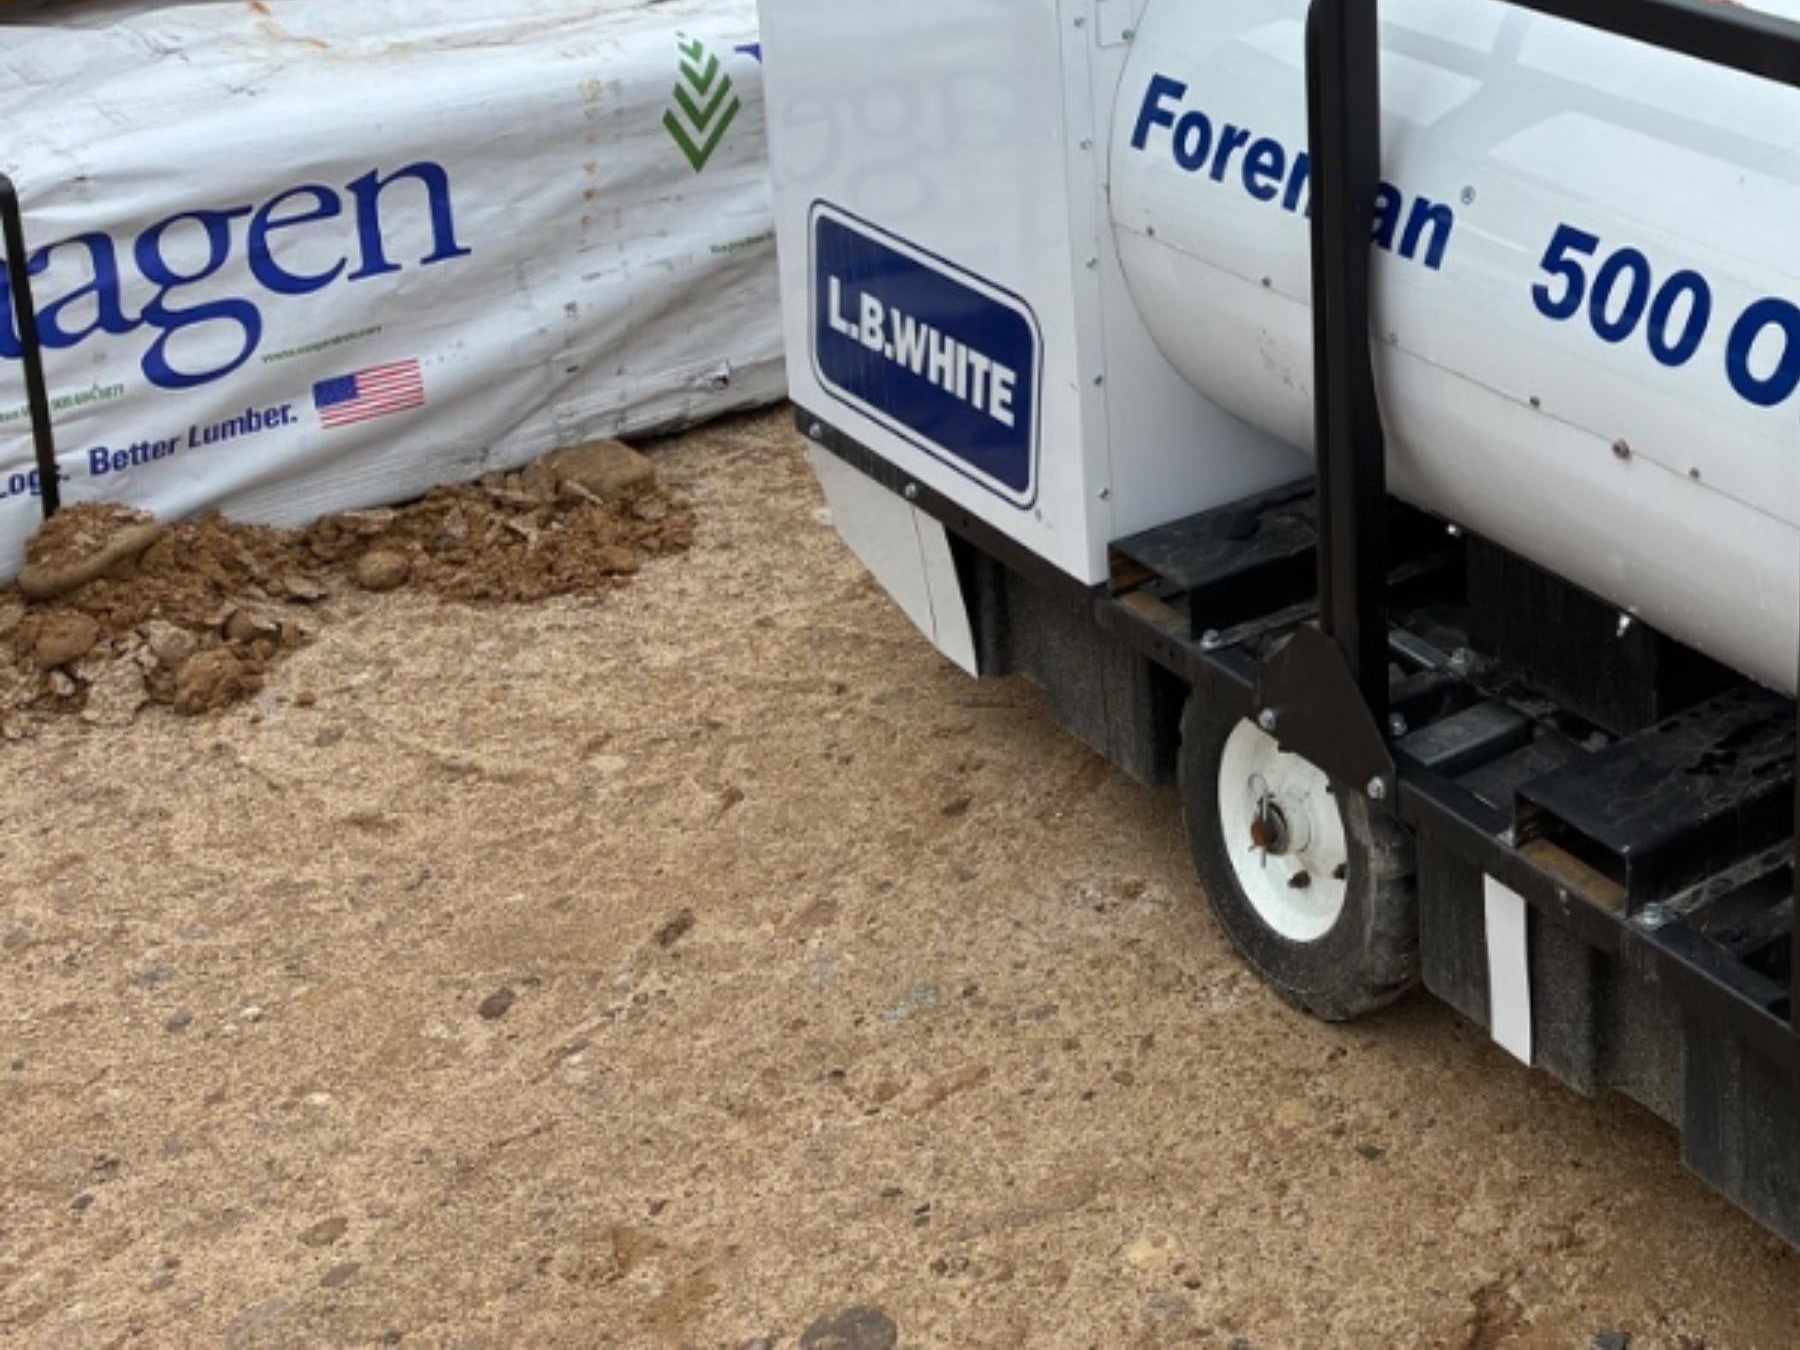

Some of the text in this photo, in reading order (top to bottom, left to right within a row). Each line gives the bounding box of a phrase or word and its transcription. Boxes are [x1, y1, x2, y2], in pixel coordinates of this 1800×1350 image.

[1532, 223, 1712, 367] 500
[89, 436, 180, 476] Better
[188, 404, 298, 448] Lumber.
